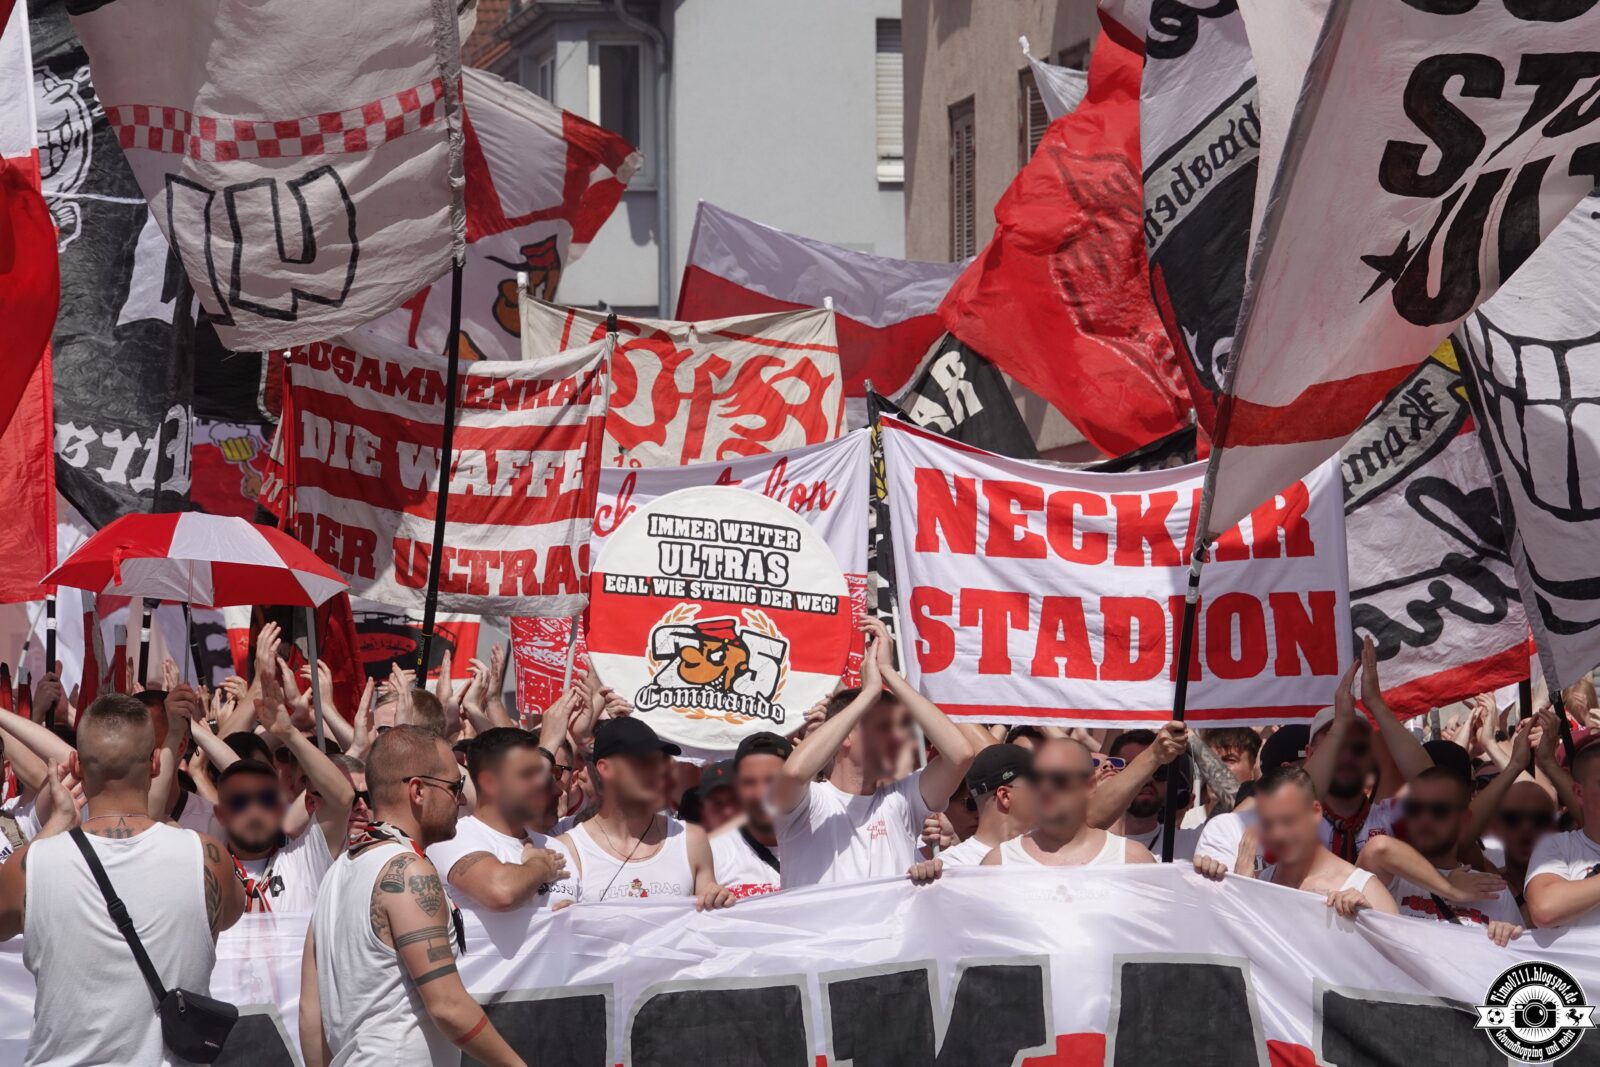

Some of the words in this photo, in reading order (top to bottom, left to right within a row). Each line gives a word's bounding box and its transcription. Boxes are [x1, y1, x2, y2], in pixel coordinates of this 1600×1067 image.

[299, 410, 382, 478] DIE
[396, 440, 588, 498] WAFFE
[649, 514, 718, 541] IMMER
[722, 526, 800, 551] WEITER
[659, 541, 789, 586] ULTRAS
[604, 574, 648, 595] EGAL
[653, 579, 688, 598] WIE
[690, 582, 757, 604] STEINIG
[759, 589, 793, 609] DER
[795, 594, 838, 613] WEG!
[911, 587, 1338, 681] STADION
[635, 685, 785, 724] Commando
